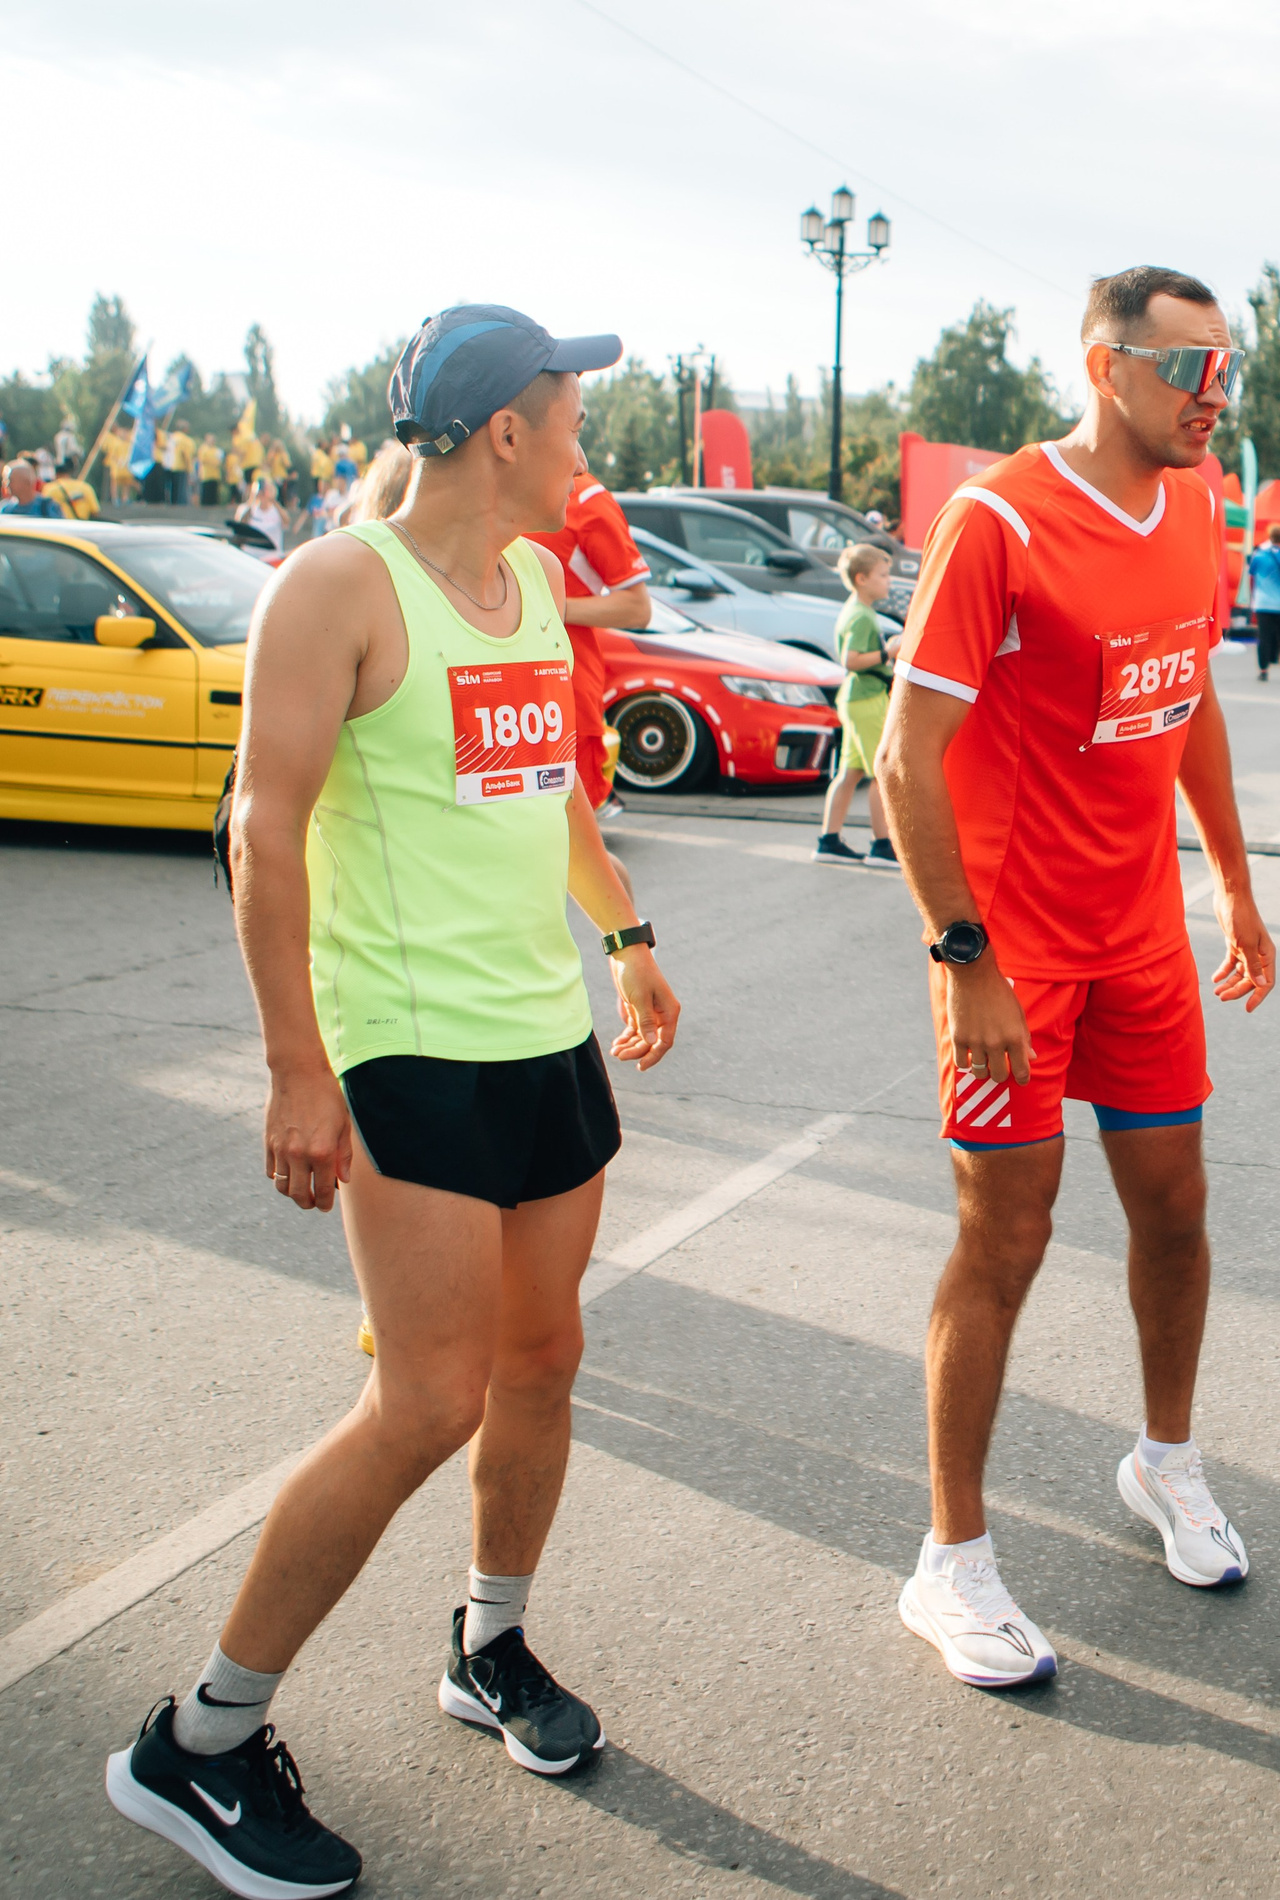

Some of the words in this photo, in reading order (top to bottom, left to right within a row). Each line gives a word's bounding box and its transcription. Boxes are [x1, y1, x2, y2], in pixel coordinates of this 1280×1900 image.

[1120, 648, 1196, 700] 2875
[474, 701, 563, 749] 1809
[505, 779, 521, 788] Банк
